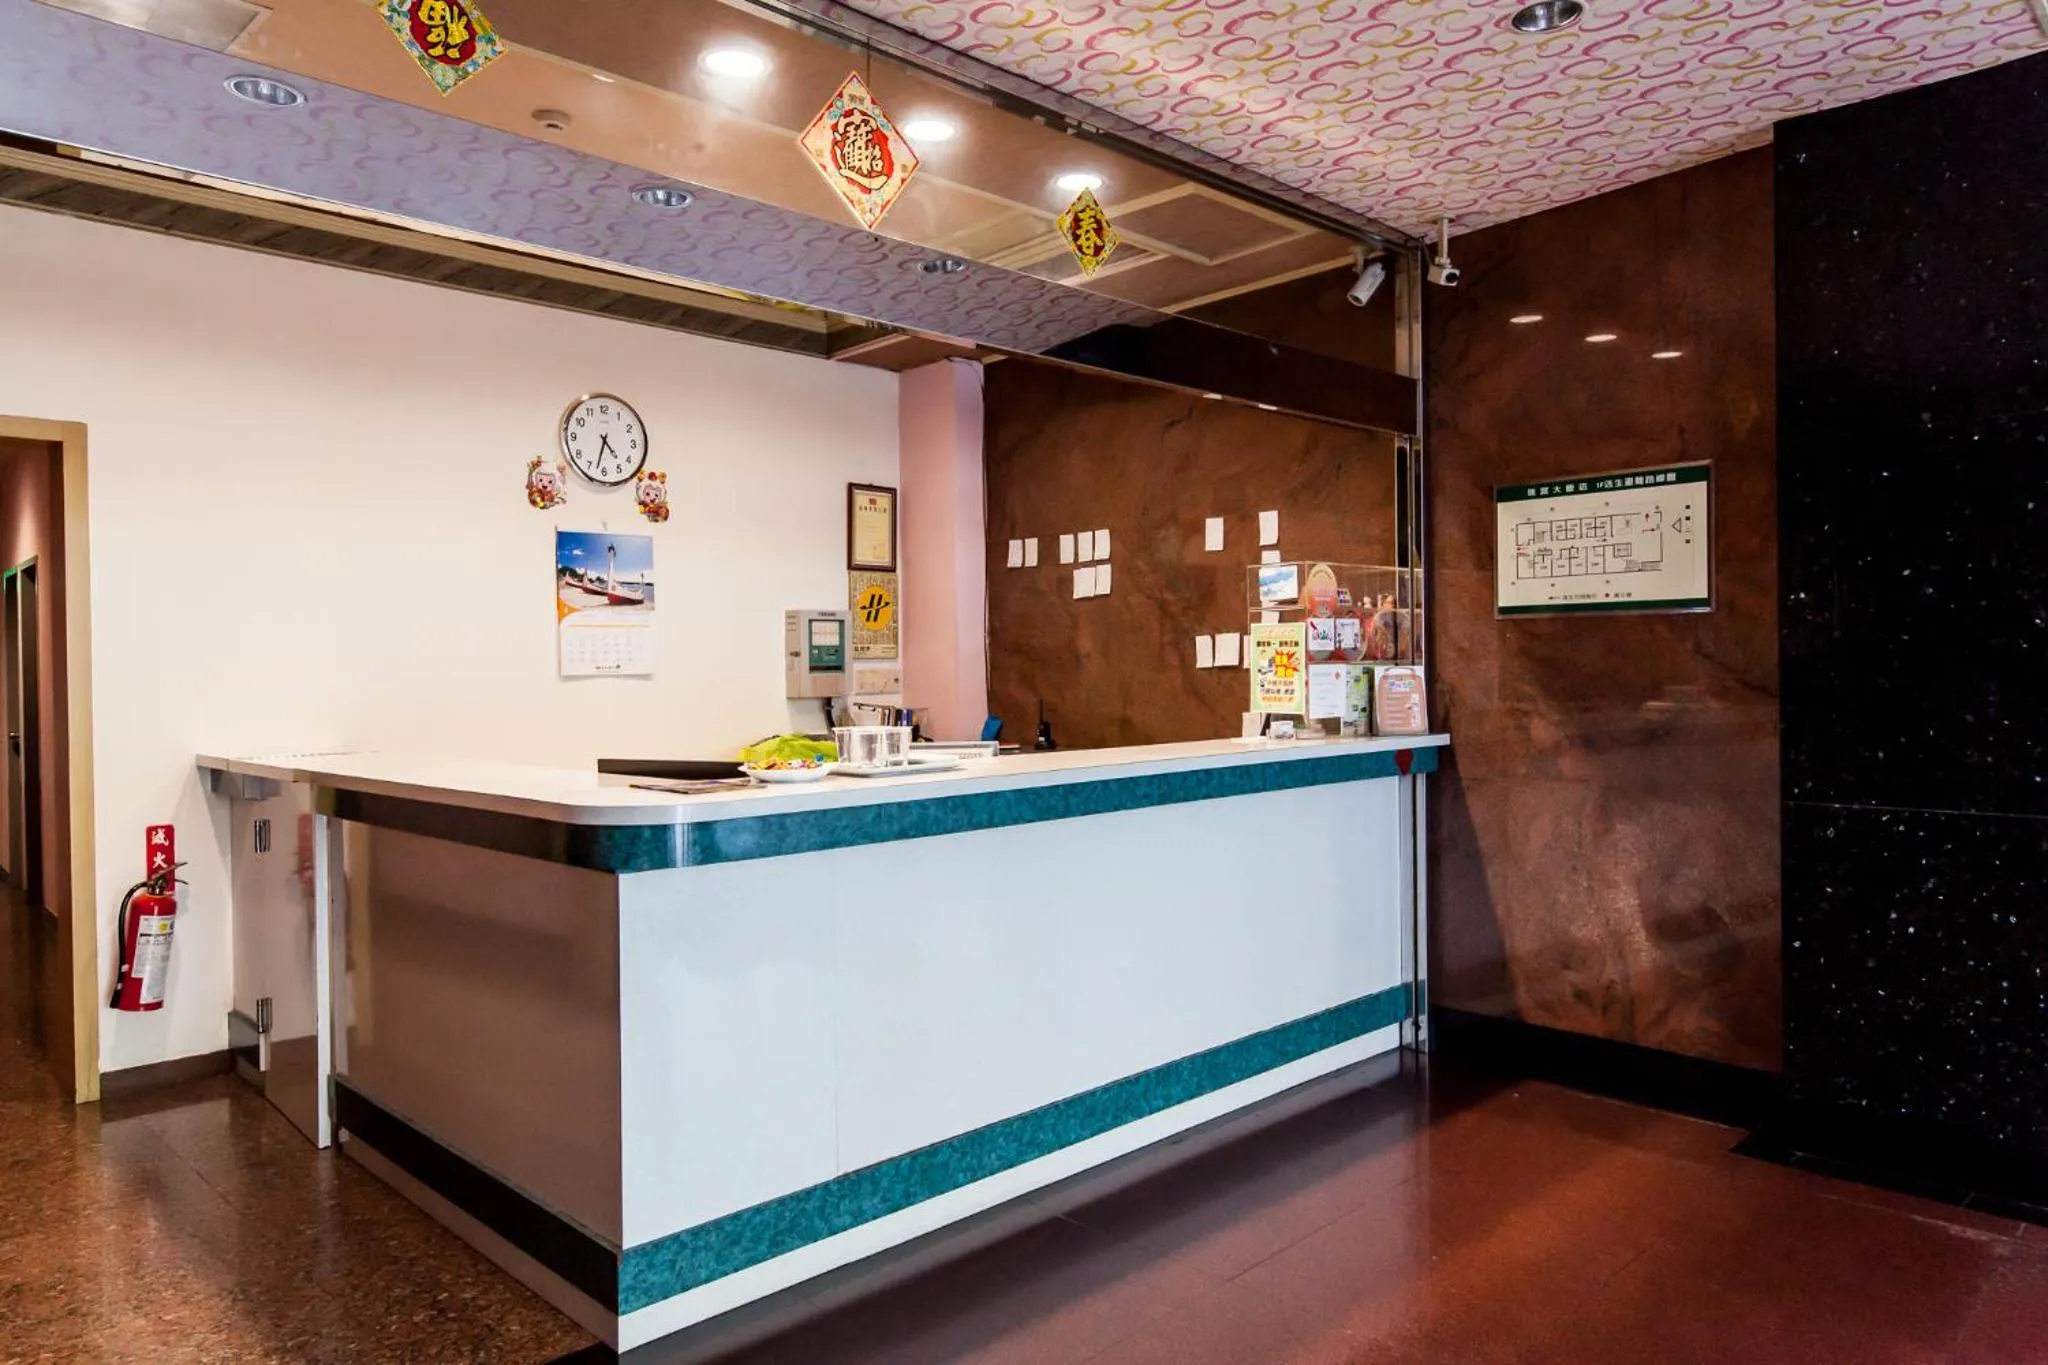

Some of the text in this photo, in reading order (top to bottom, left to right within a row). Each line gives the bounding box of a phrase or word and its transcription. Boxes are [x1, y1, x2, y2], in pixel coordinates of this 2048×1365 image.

[1075, 207, 1104, 255] 春
[586, 407, 594, 417] 11
[600, 405, 609, 415] 12
[616, 411, 621, 422] 1
[575, 417, 585, 428] 10
[626, 424, 633, 434] 2
[570, 432, 577, 442] 9
[630, 439, 637, 449] 3
[576, 448, 583, 459] 8
[626, 455, 632, 464] 4
[587, 461, 593, 470] 7
[616, 464, 622, 474] 5
[601, 466, 607, 477] 6
